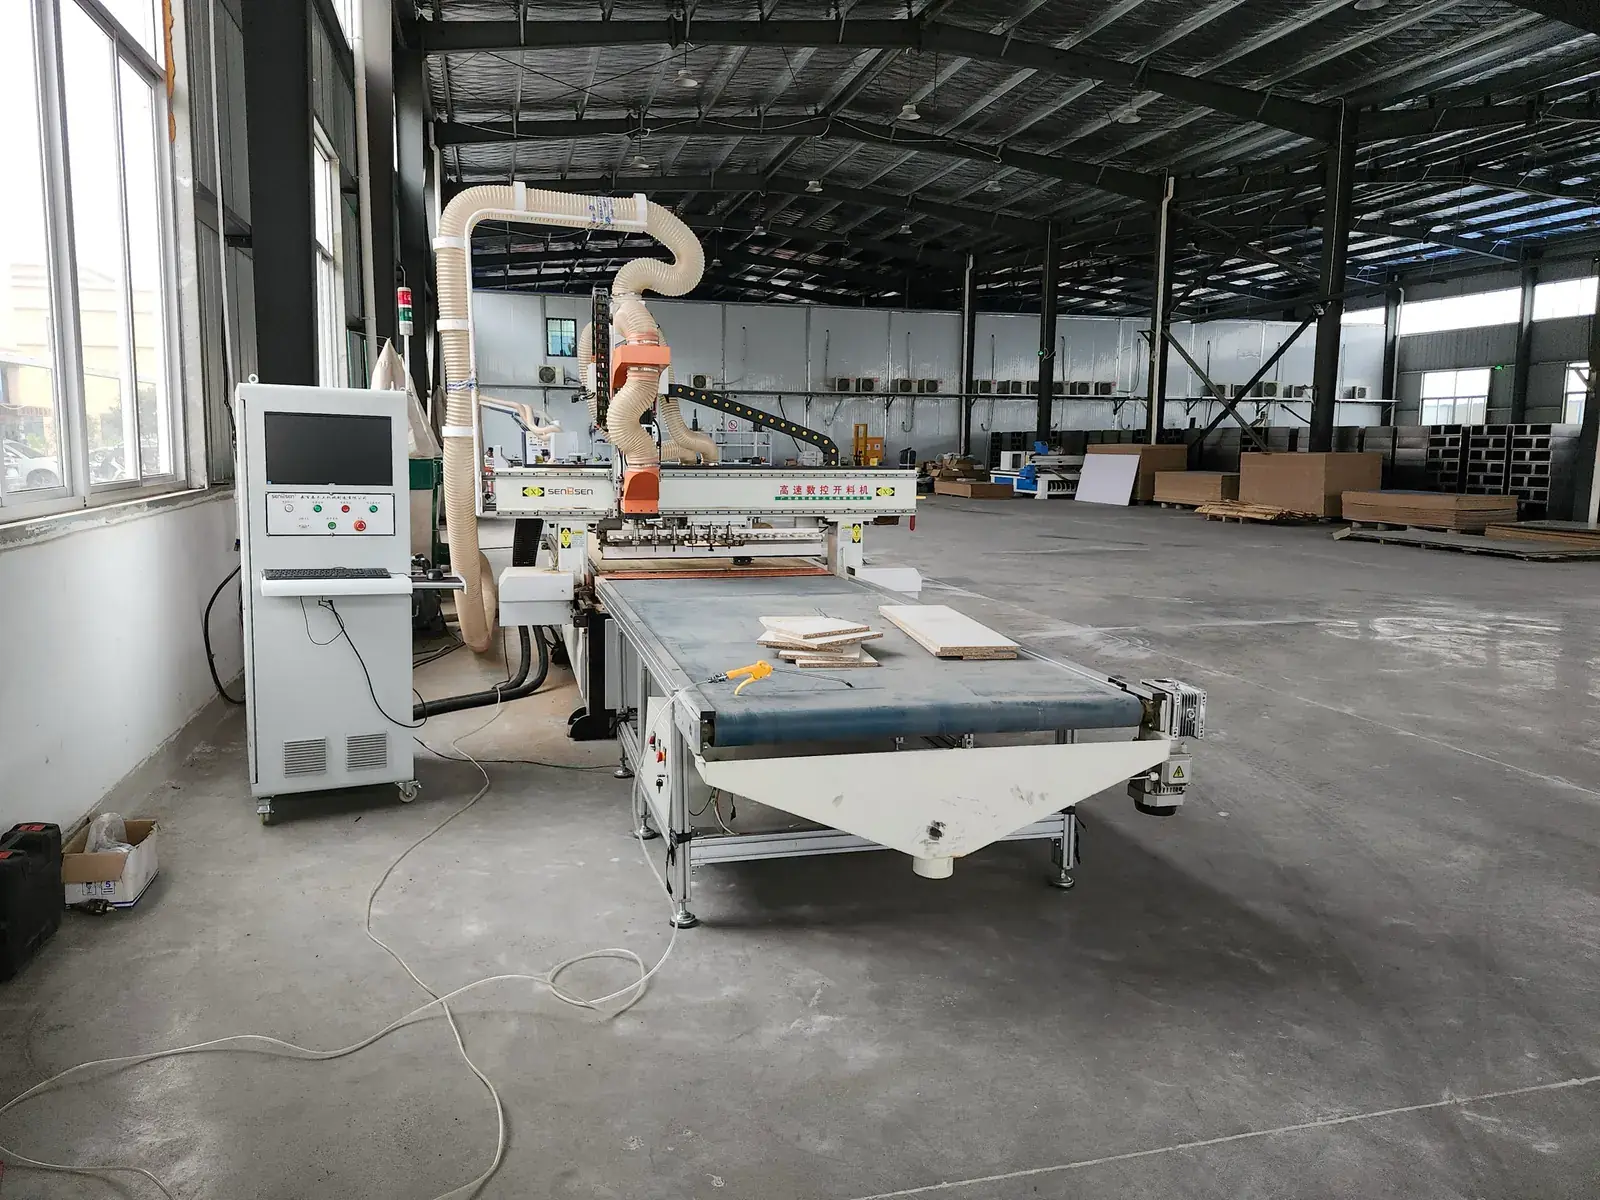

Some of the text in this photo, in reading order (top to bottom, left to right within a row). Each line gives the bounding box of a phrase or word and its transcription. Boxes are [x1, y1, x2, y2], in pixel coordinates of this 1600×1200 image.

[779, 484, 869, 495] 高速数控开料机
